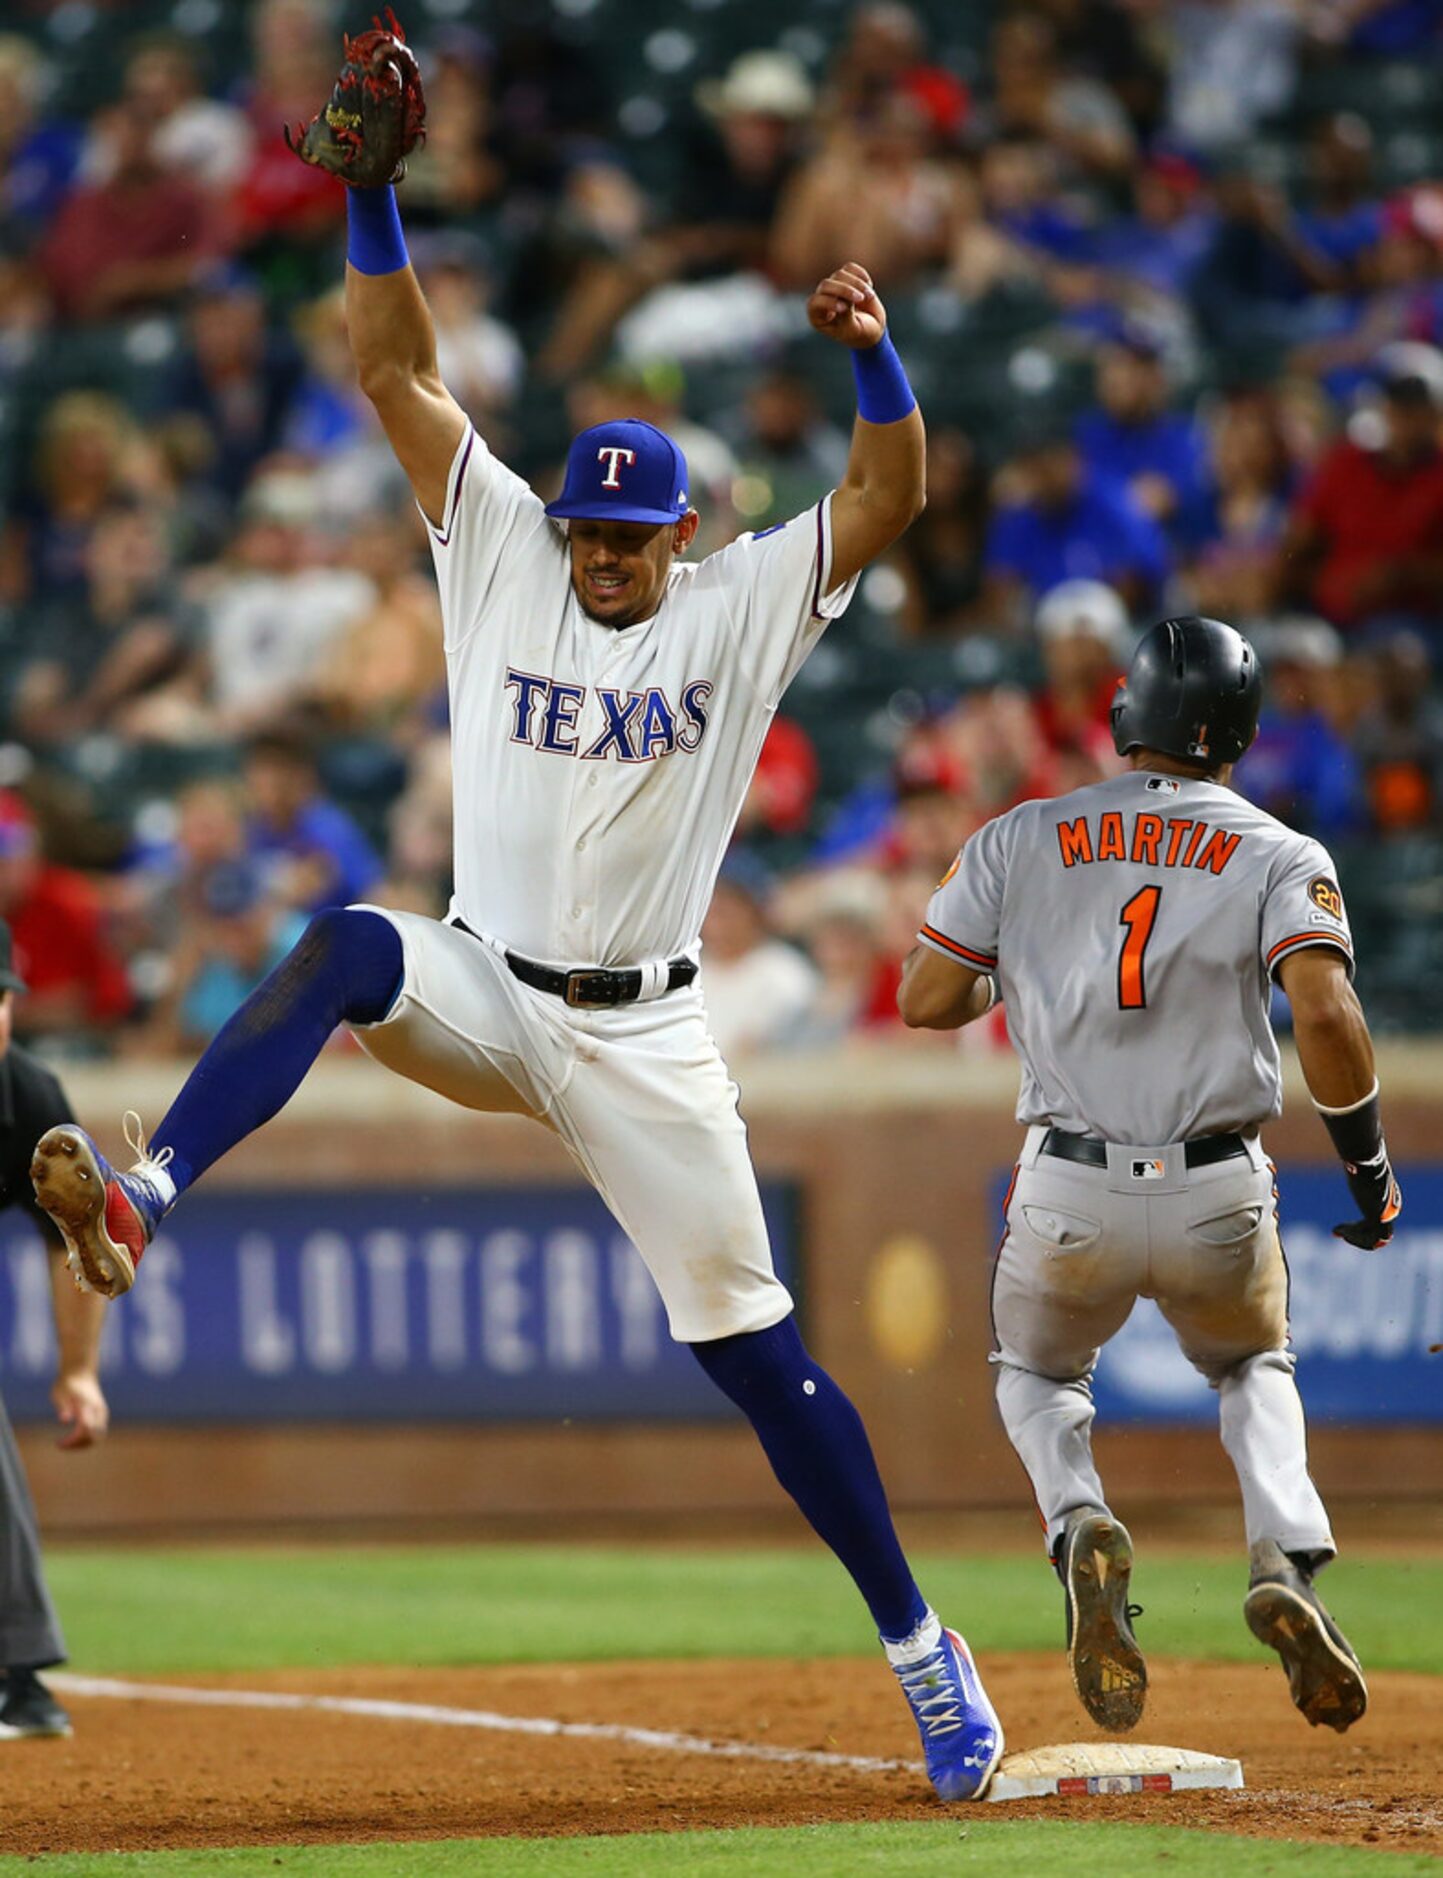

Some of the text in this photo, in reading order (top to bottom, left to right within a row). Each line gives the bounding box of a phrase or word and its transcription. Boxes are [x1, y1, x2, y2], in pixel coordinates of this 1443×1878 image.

[598, 447, 635, 490] T
[504, 666, 713, 763] TEXAS
[1057, 812, 1242, 876] MARTIN
[1119, 885, 1162, 1009] 1
